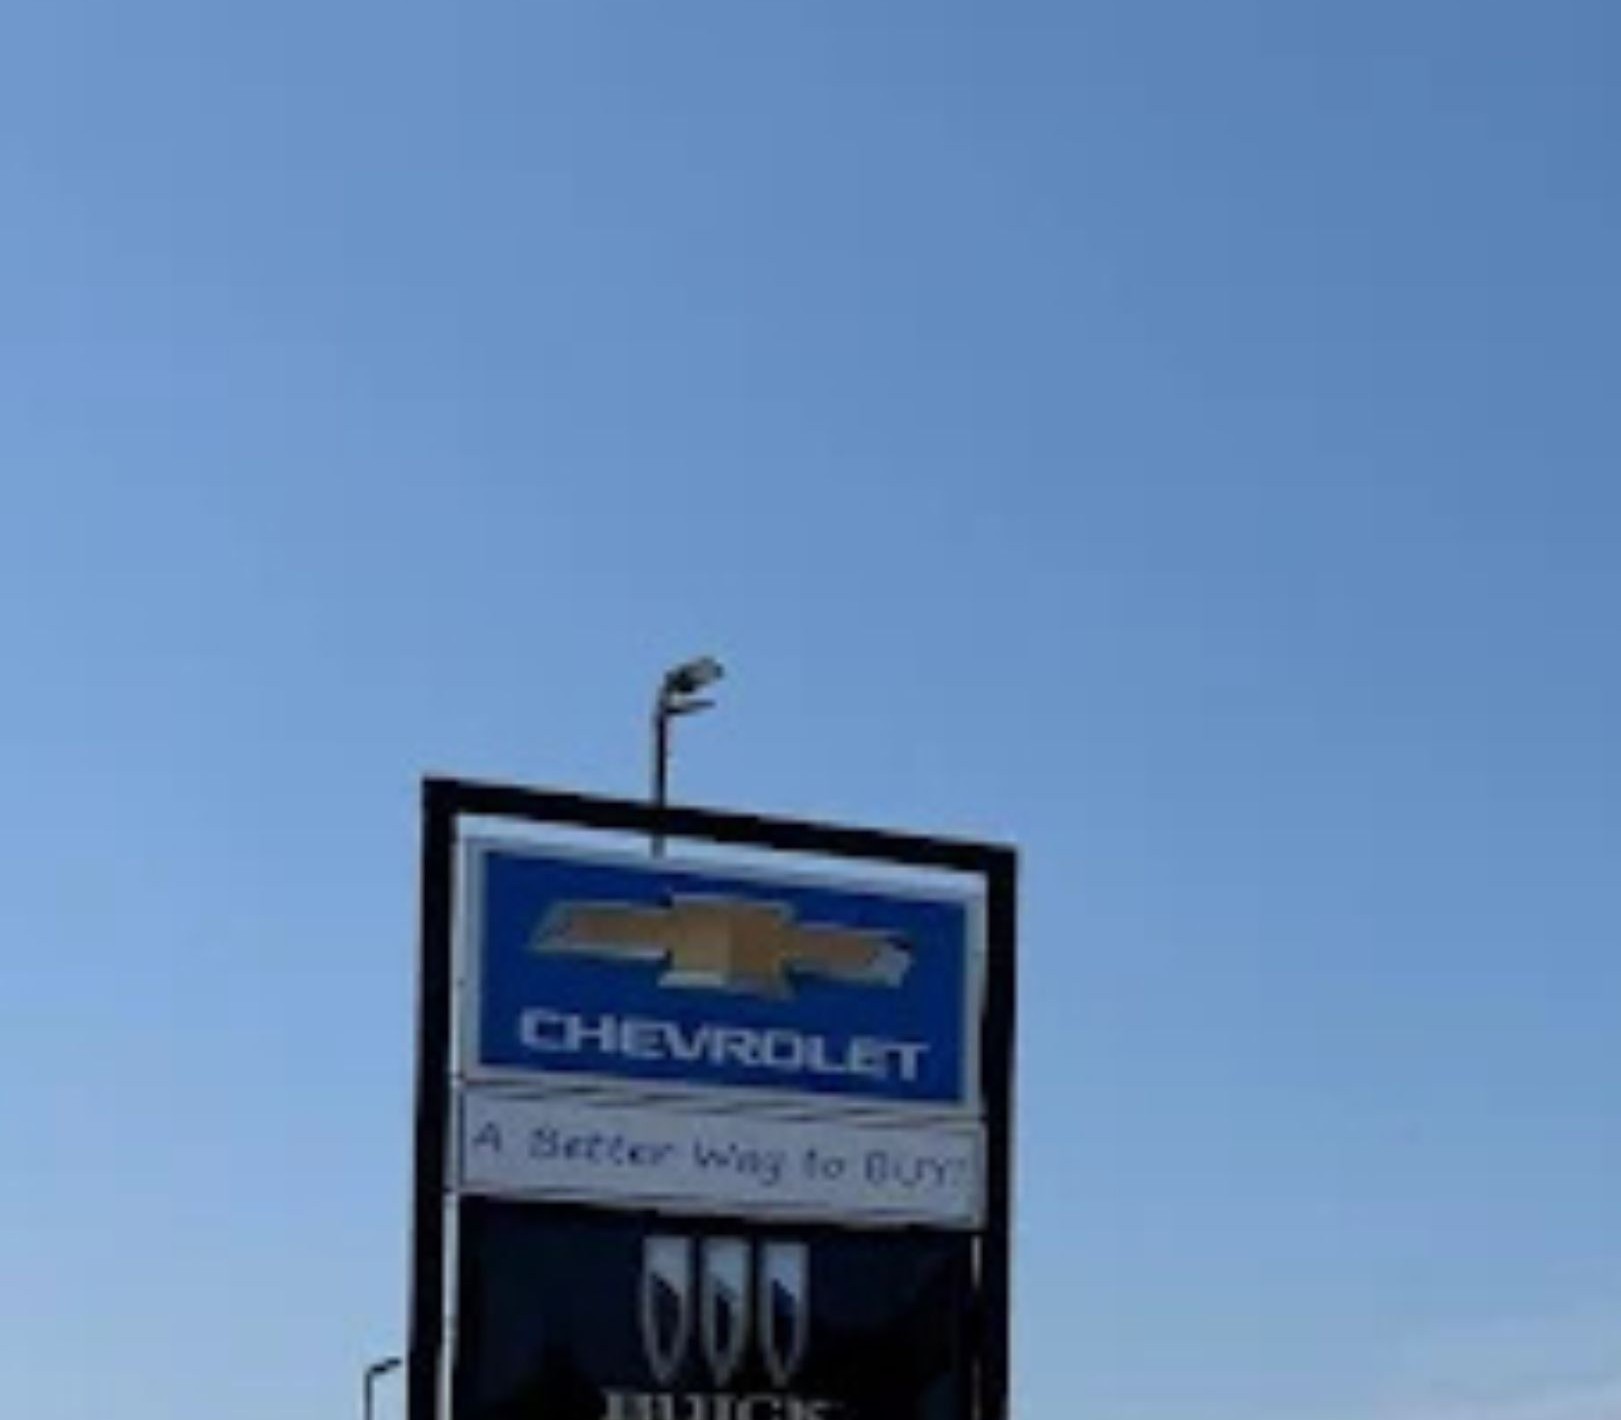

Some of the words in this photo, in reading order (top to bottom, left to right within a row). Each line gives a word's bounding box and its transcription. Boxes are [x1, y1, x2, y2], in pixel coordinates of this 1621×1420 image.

[519, 1006, 930, 1081] CHEVROLET
[472, 1120, 502, 1153] A
[529, 1126, 673, 1167] Better
[694, 1139, 789, 1188] Way
[806, 1148, 845, 1179] to
